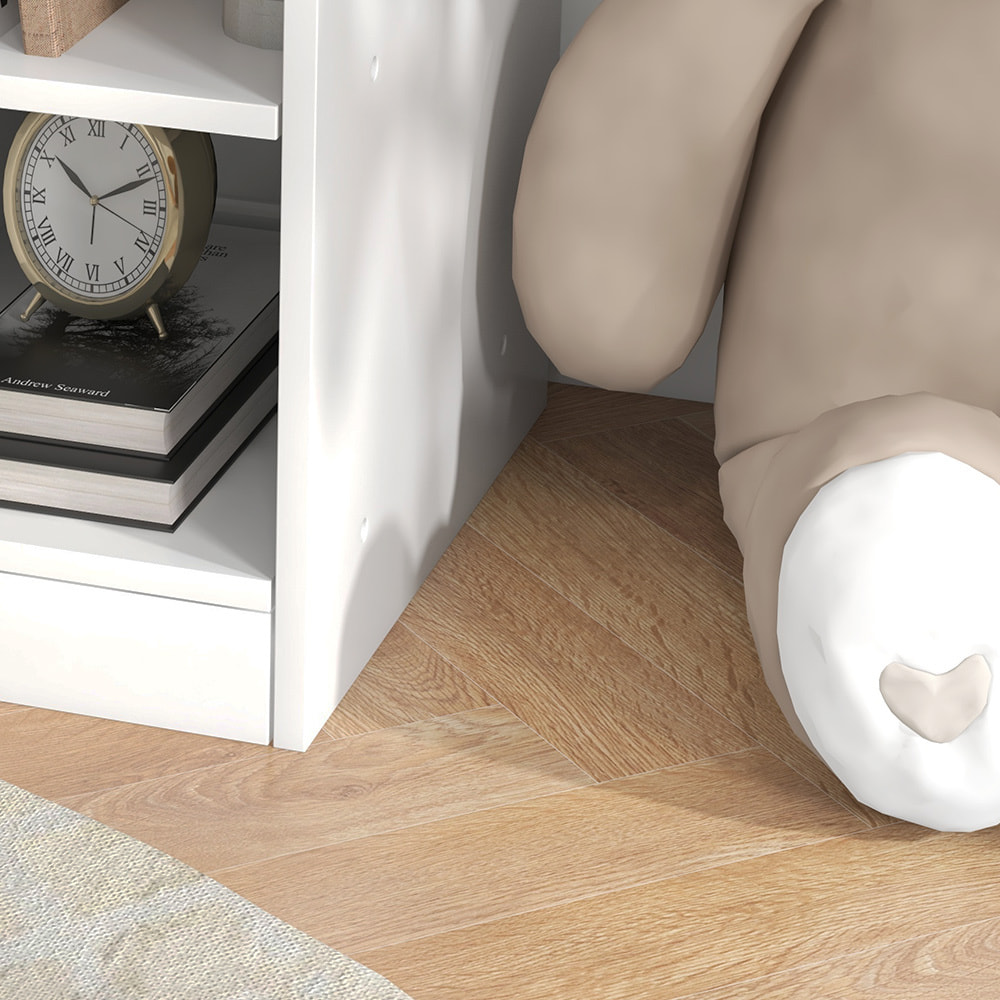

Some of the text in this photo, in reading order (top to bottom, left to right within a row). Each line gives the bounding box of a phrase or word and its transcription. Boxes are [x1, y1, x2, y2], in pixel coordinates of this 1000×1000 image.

[59, 125, 76, 147] XI
[87, 118, 106, 138] XII
[40, 149, 55, 168] X
[136, 162, 151, 178] II
[32, 186, 46, 205] IX
[143, 199, 157, 216] III
[37, 216, 57, 247] VIII
[134, 230, 151, 254] IV
[56, 247, 75, 273] VII
[113, 256, 126, 275] V
[85, 263, 100, 282] VI
[0, 376, 111, 398] Andrew Seaward
